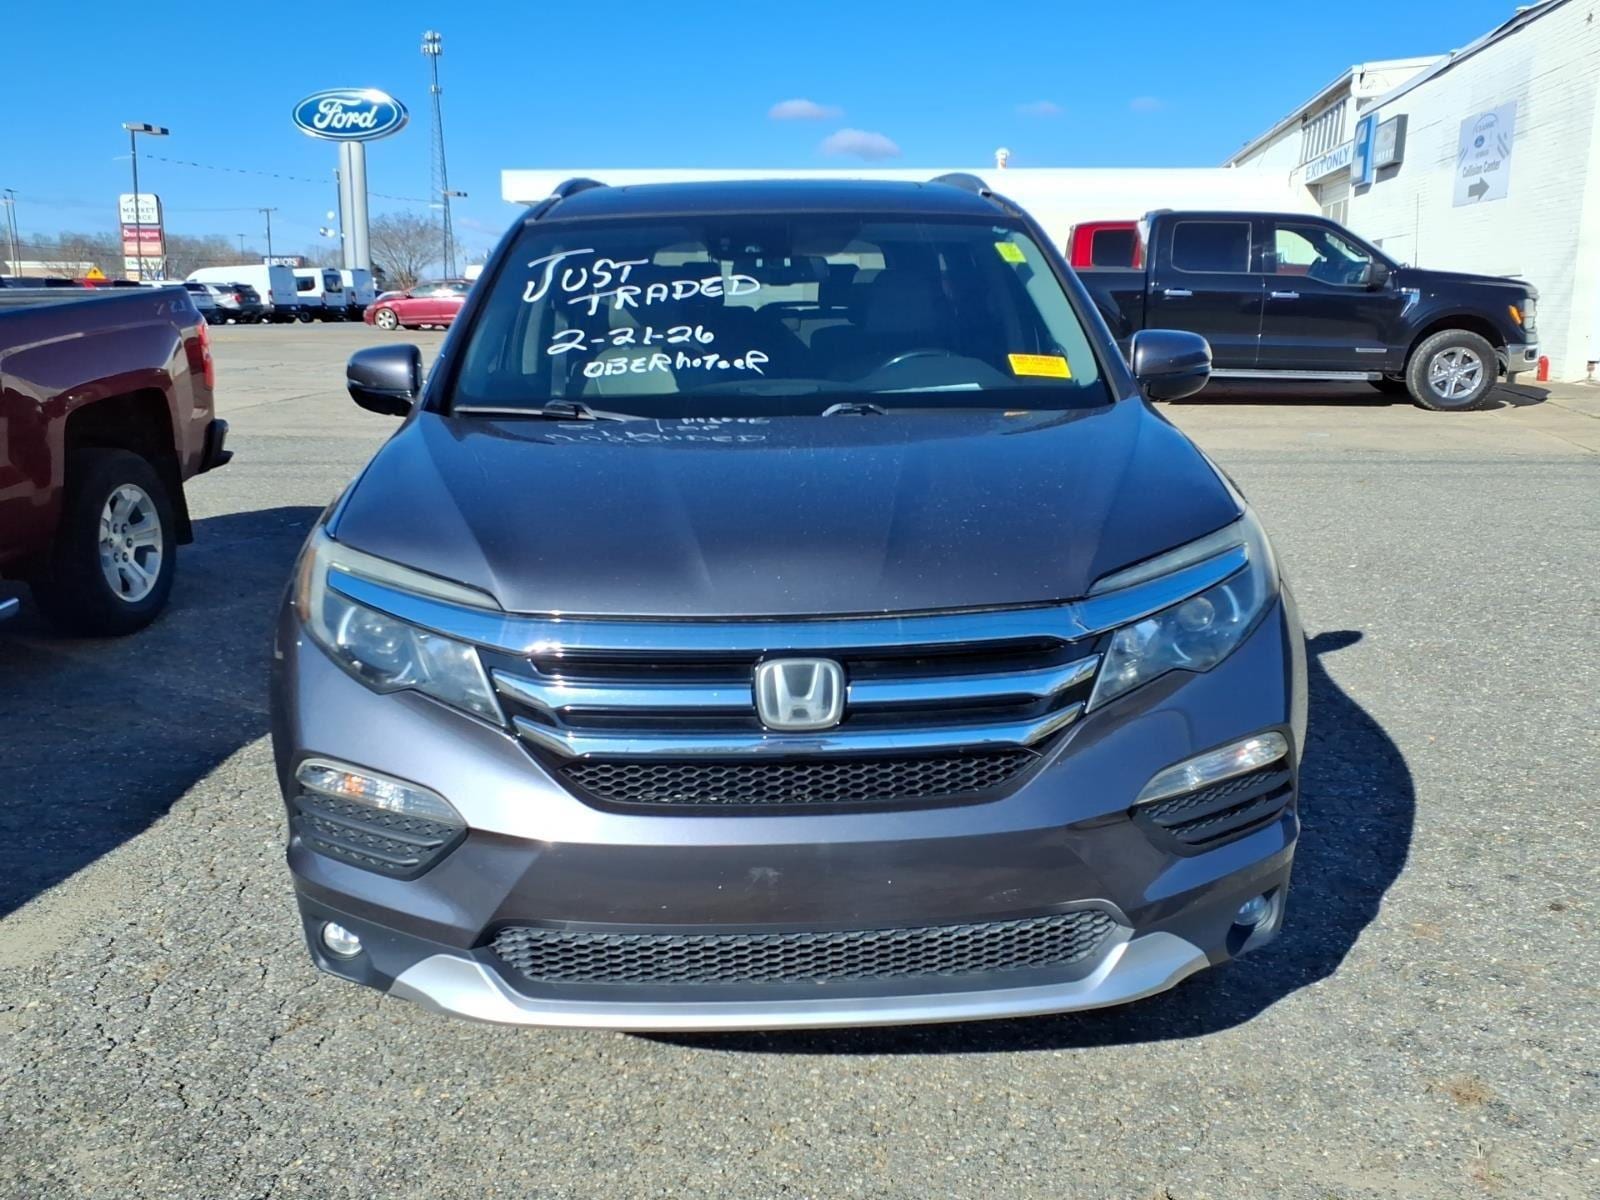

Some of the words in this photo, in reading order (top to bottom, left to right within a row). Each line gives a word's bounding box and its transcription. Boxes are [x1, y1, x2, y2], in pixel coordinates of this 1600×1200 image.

[313, 98, 378, 129] Ford
[1305, 155, 1326, 181] EXIT
[1327, 146, 1351, 171] ONLY
[1484, 160, 1501, 174] Center
[523, 248, 649, 302] JUST
[568, 275, 760, 316] TRADED
[547, 325, 715, 355] 2-21-26
